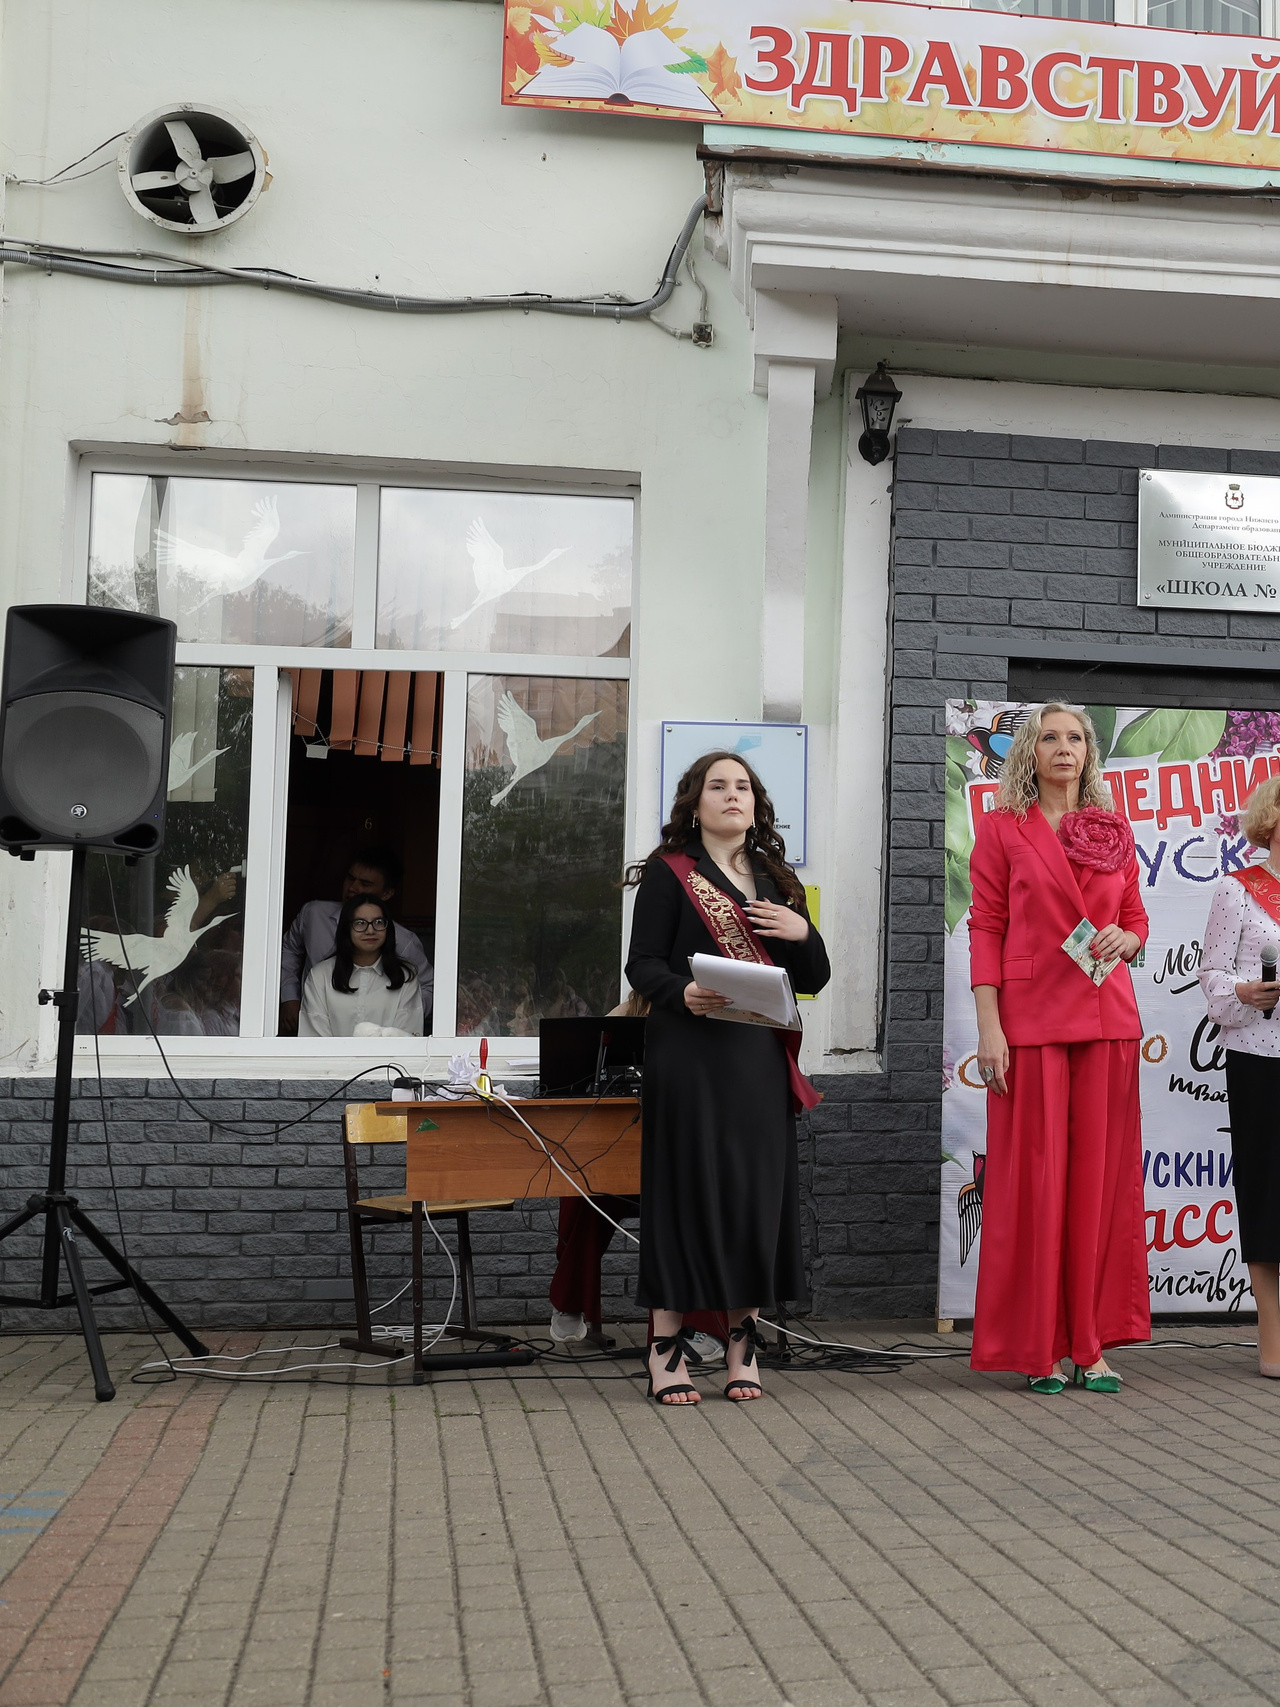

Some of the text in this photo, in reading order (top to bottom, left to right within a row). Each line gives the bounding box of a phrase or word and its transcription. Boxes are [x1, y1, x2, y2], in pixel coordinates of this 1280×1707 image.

[1158, 511, 1217, 522] Администрация
[1245, 515, 1279, 524] Нижнего
[1191, 522, 1240, 532] Департамент
[1158, 539, 1246, 551] МУНИЦИПАЛЬНОЕ
[1202, 561, 1267, 572] УЧРЕЖДЕНИЕ
[1156, 579, 1248, 598] «ШКОЛА
[1253, 583, 1277, 599] №
[703, 892, 757, 964] Выпуск
[1144, 1199, 1234, 1253] асс
